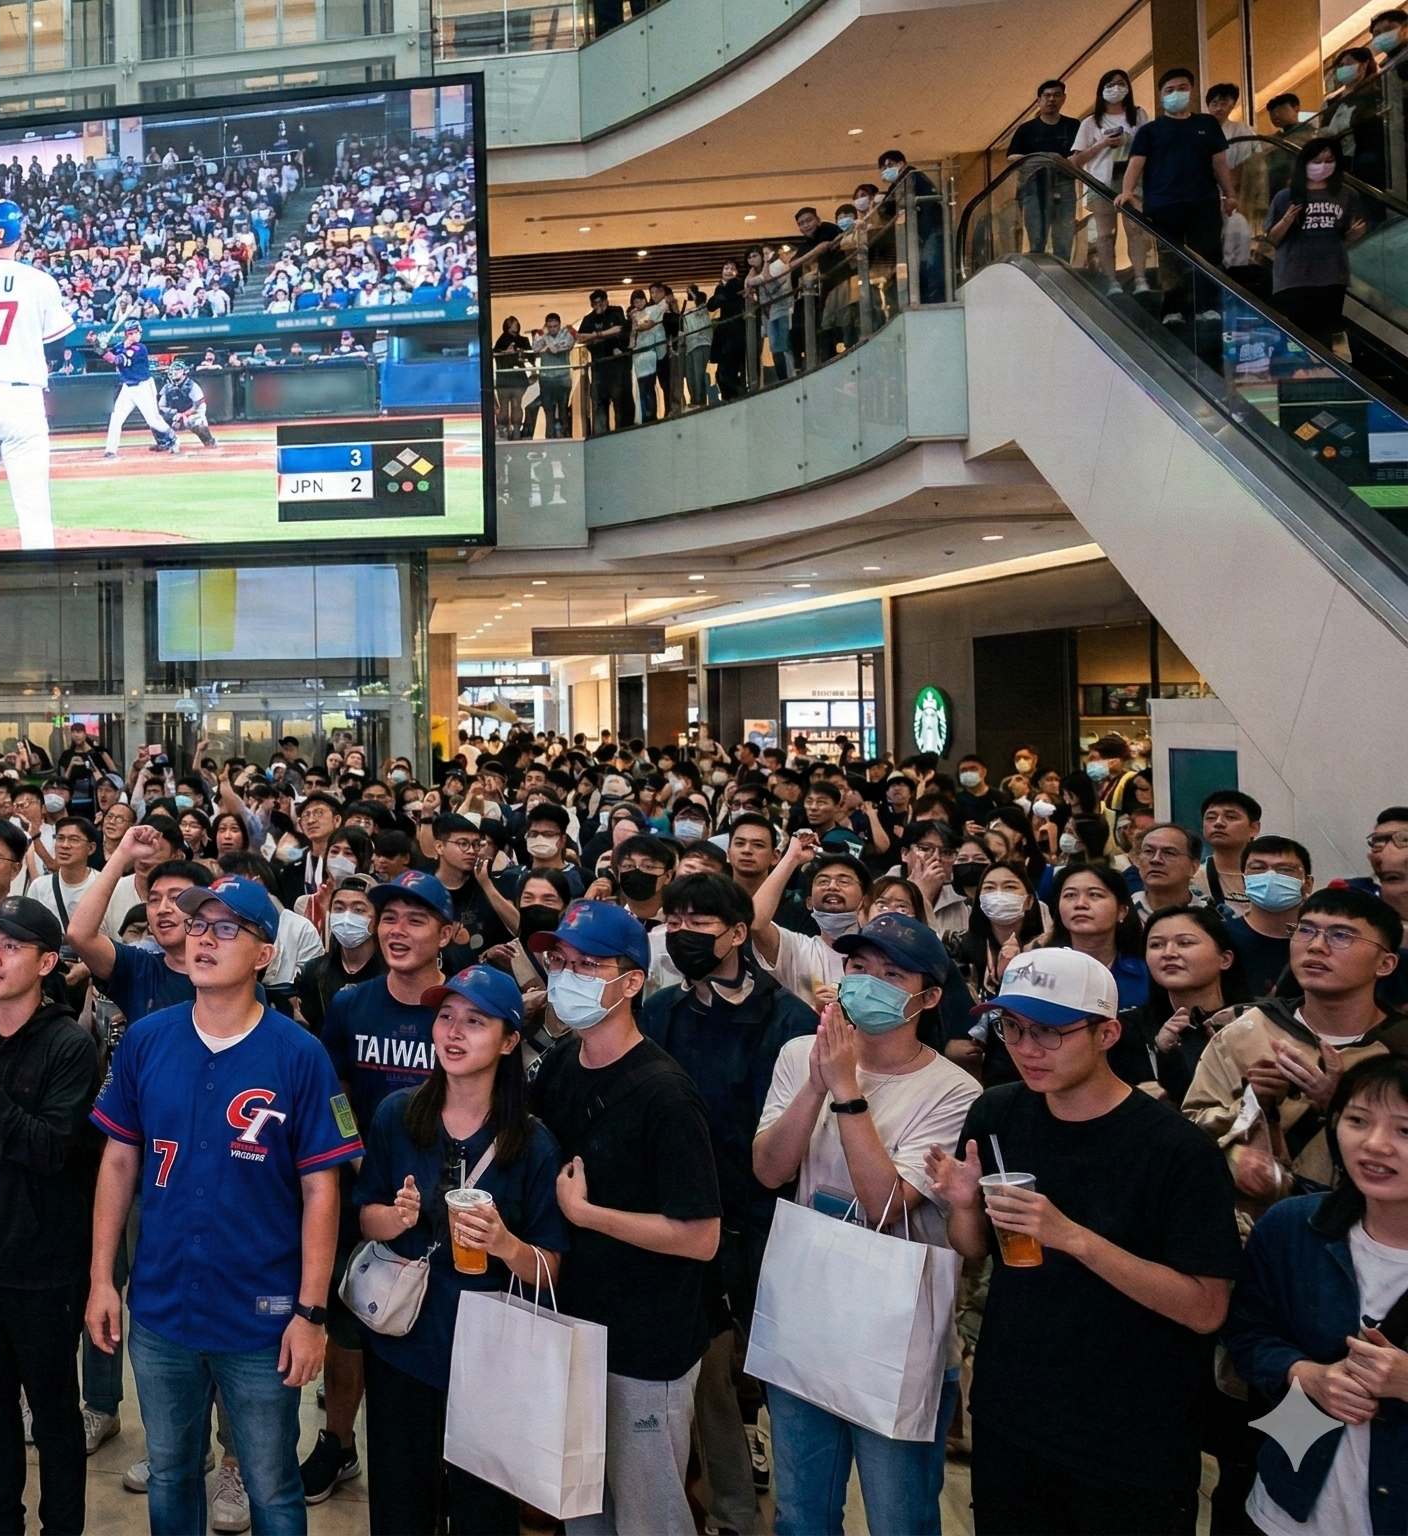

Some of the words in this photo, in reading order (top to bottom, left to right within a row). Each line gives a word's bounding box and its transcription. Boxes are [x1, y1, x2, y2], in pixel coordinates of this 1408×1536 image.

[350, 448, 362, 467] 3
[291, 478, 323, 494] JPN
[351, 477, 362, 493] 2
[355, 1034, 436, 1070] TAIWA
[153, 1138, 179, 1188] 7
